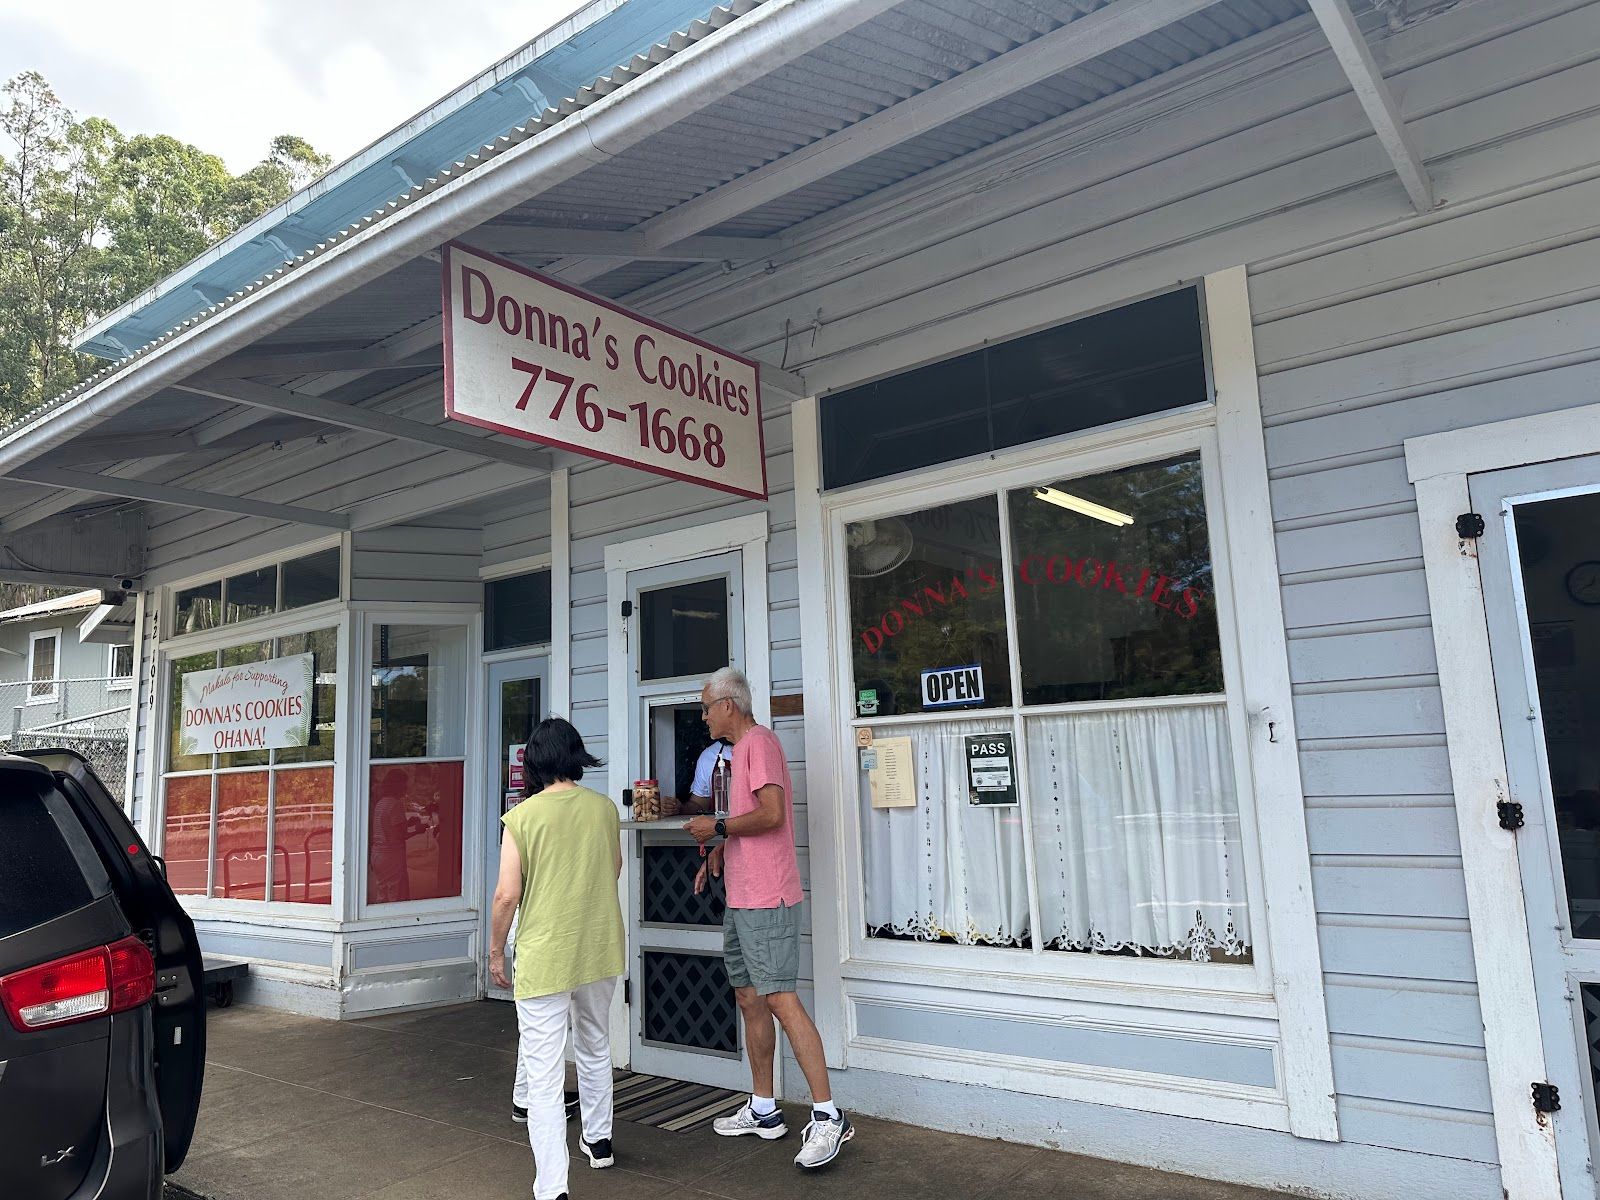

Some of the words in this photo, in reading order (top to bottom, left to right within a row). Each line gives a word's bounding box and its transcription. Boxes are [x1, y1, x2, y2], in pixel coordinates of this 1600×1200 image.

[461, 264, 619, 370] Donna's
[633, 334, 750, 416] Cookies
[511, 356, 726, 469] 776-1668
[859, 562, 998, 654] DONNA'S
[1018, 553, 1204, 620] COOKIES
[231, 668, 244, 689] for
[244, 666, 288, 695] Supporting
[926, 669, 980, 703] OPEN
[185, 703, 242, 727] DONNA'S
[245, 695, 303, 721] COOKIES
[214, 726, 266, 749] OHANA!
[971, 742, 1006, 756] PASS
